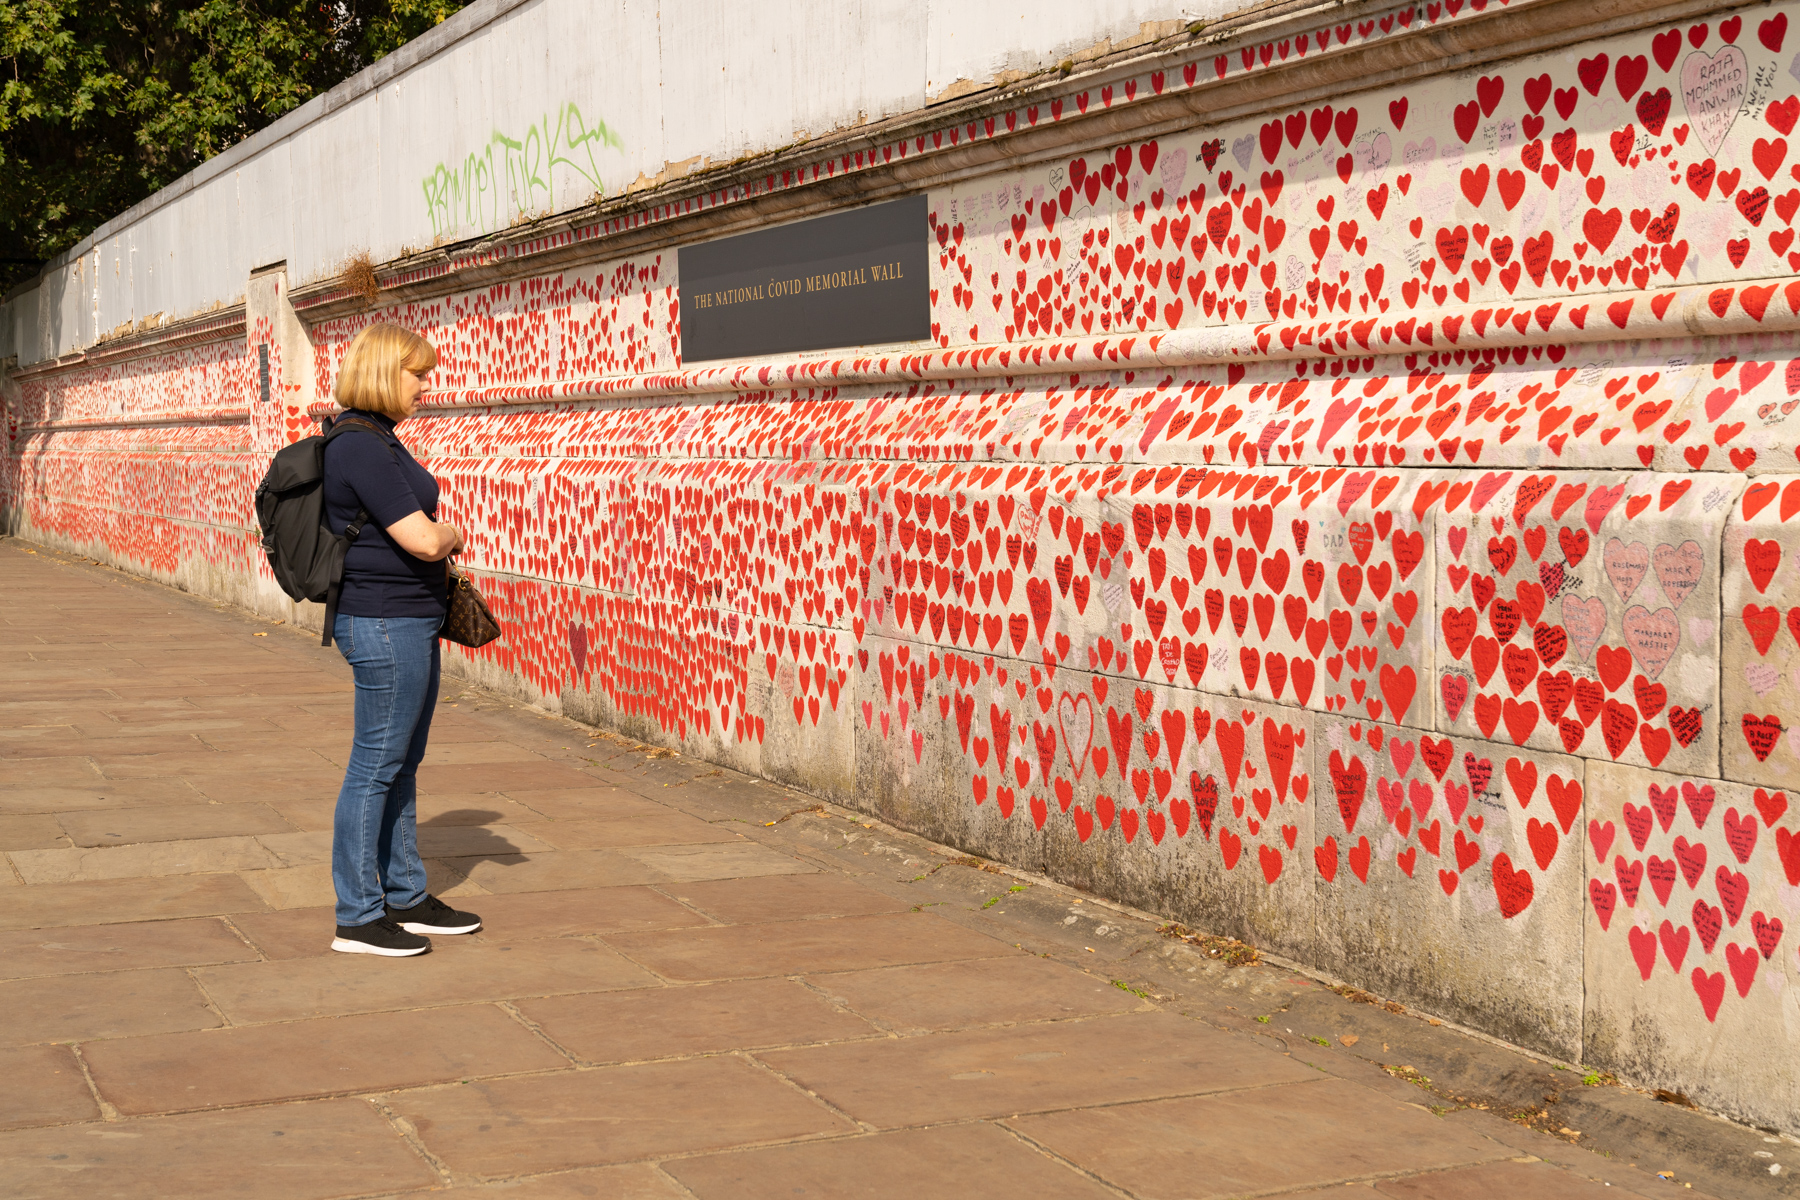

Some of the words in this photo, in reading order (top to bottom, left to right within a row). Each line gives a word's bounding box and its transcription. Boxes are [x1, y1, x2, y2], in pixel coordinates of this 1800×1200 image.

[1701, 54, 1733, 79] RAJA
[1699, 83, 1743, 116] ANWAR
[1701, 107, 1731, 134] KHAN
[693, 293, 713, 310] THE
[715, 284, 765, 307] NATIONAL
[767, 279, 802, 299] COVID
[805, 267, 867, 293] MEMORIAL
[870, 261, 904, 283] WALL
[1323, 534, 1344, 548] DAD
